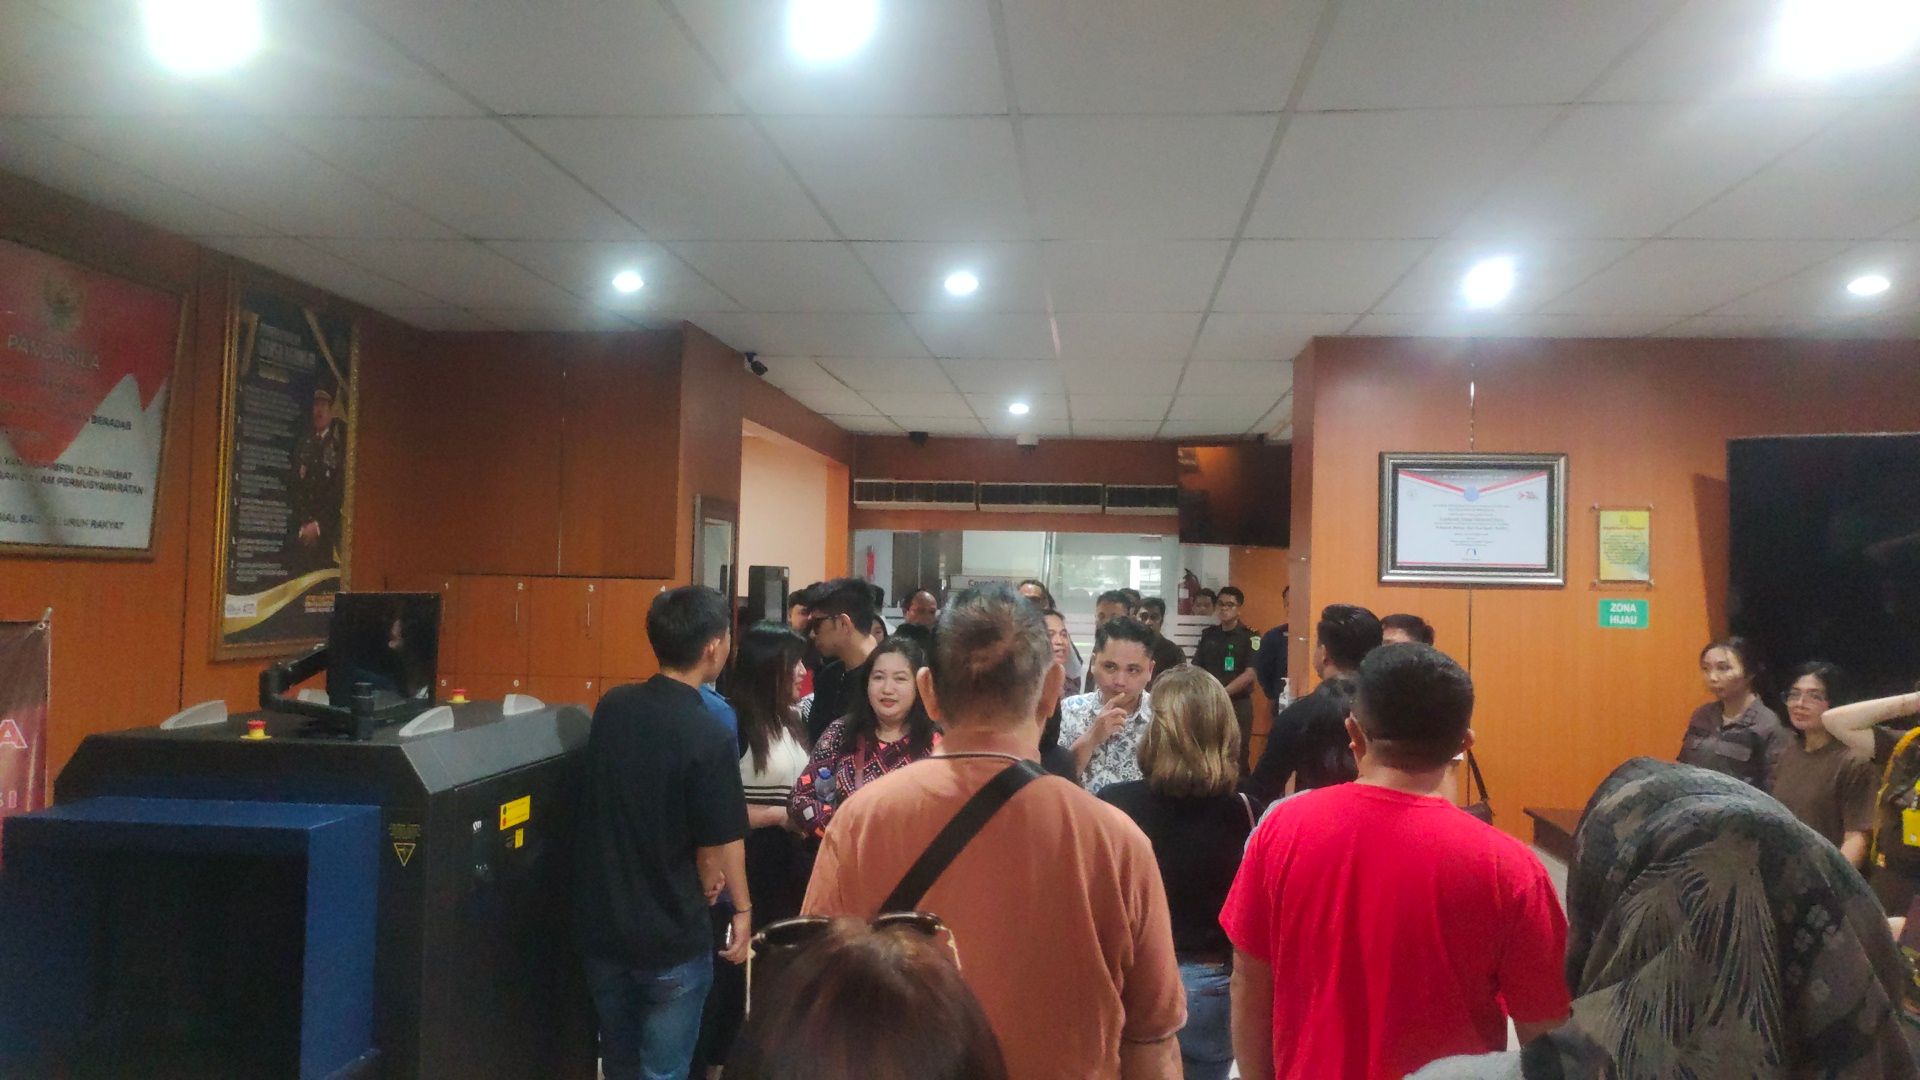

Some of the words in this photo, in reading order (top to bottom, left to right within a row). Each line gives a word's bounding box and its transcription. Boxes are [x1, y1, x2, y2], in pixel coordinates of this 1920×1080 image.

[8, 334, 100, 371] PANCASILA
[517, 582, 524, 590] 2
[588, 584, 594, 592] 3
[1609, 602, 1637, 613] ZONA
[1609, 615, 1638, 625] HIJAU
[513, 679, 520, 687] 6
